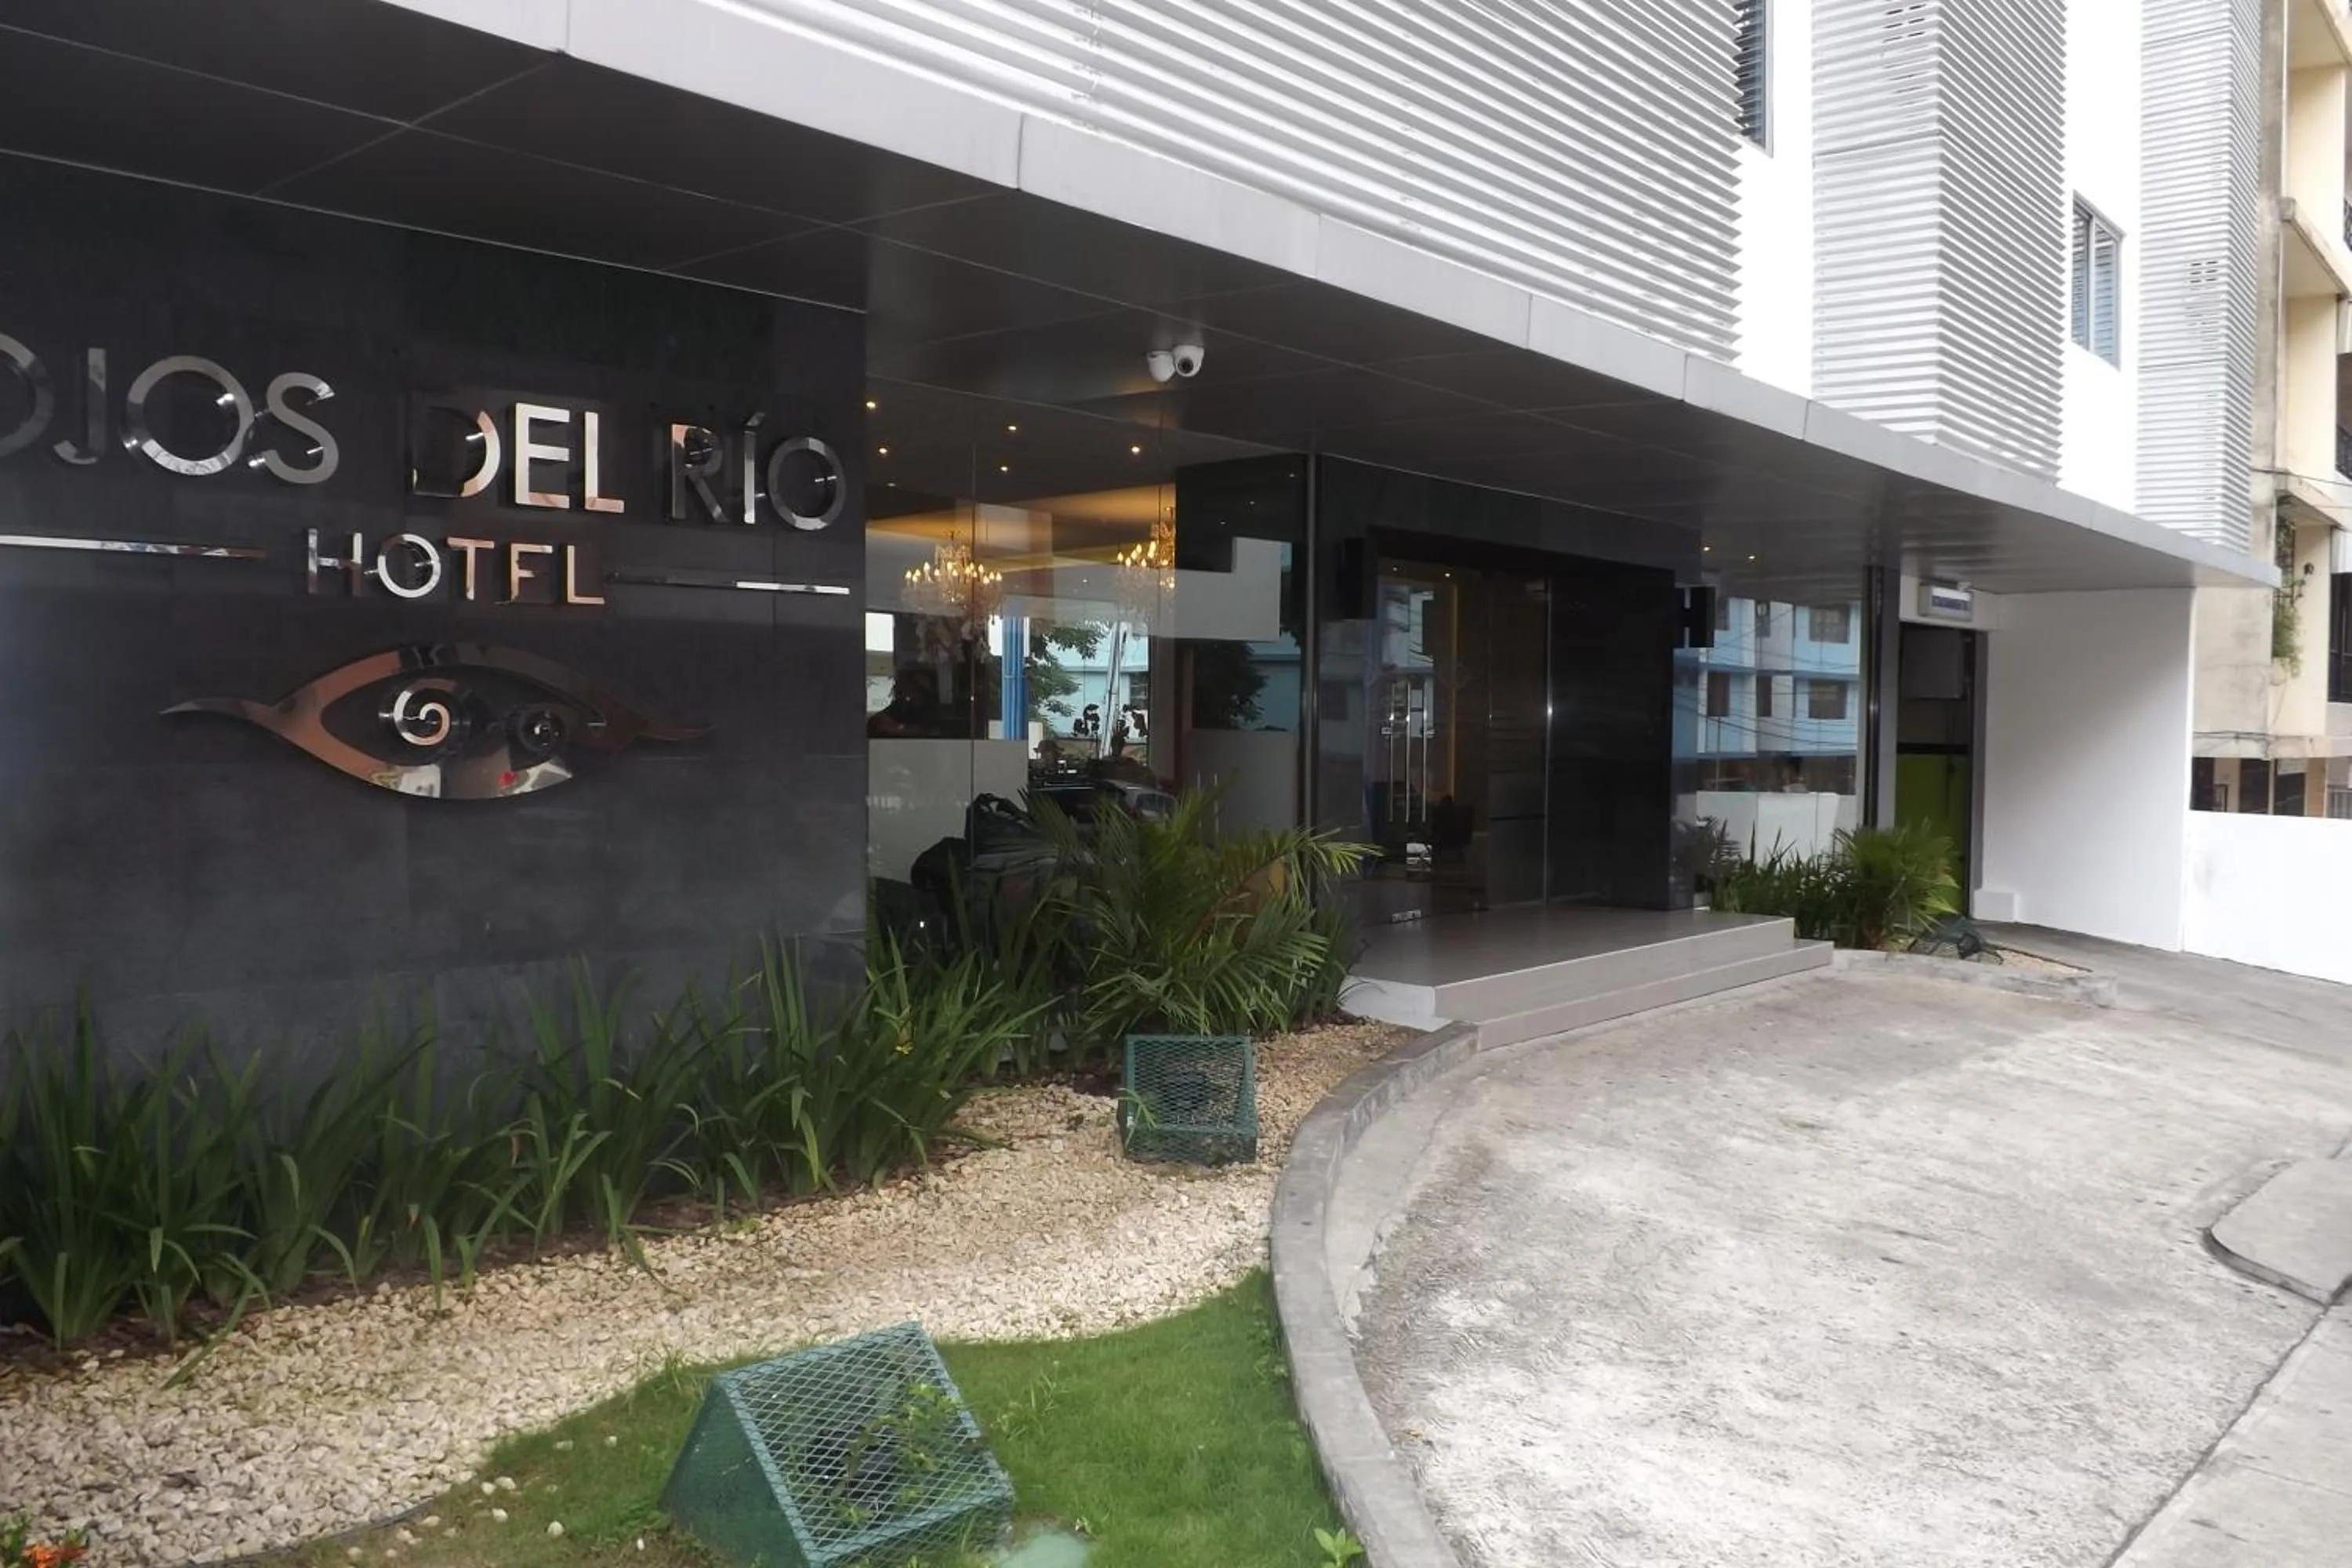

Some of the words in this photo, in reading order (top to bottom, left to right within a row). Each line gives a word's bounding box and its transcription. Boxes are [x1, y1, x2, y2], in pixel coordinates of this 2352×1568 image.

[411, 401, 625, 514] DEL
[672, 412, 846, 531] RÍO
[308, 528, 605, 605] HOTEL
